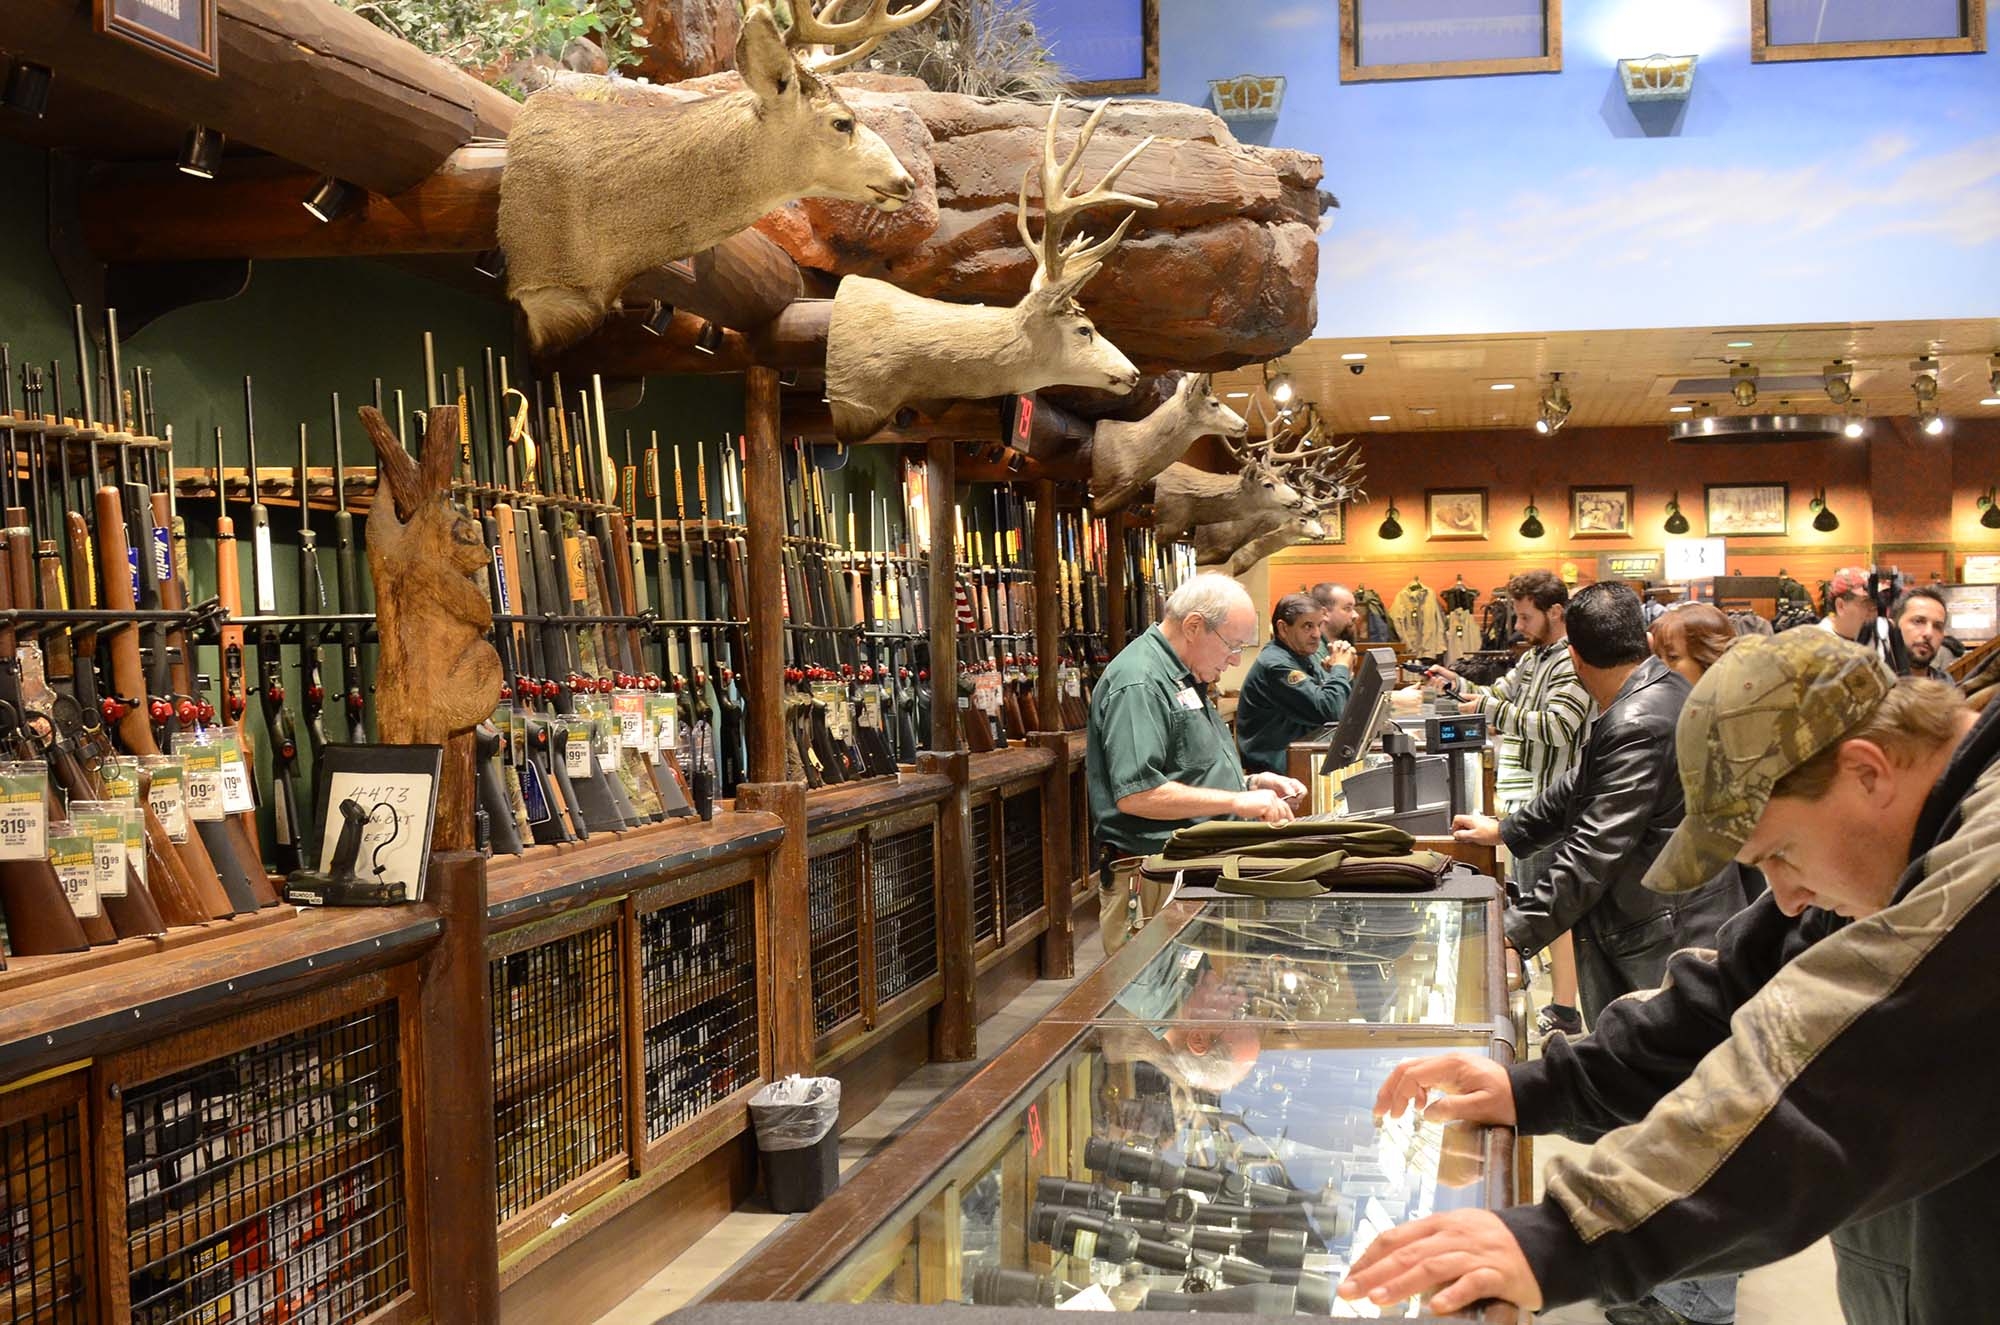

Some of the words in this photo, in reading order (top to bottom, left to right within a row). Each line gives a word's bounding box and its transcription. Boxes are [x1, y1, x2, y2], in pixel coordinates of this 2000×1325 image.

[154, 536, 170, 580] Marlin
[349, 786, 410, 804] 4473
[0, 819, 26, 834] 319
[79, 879, 88, 887] 99
